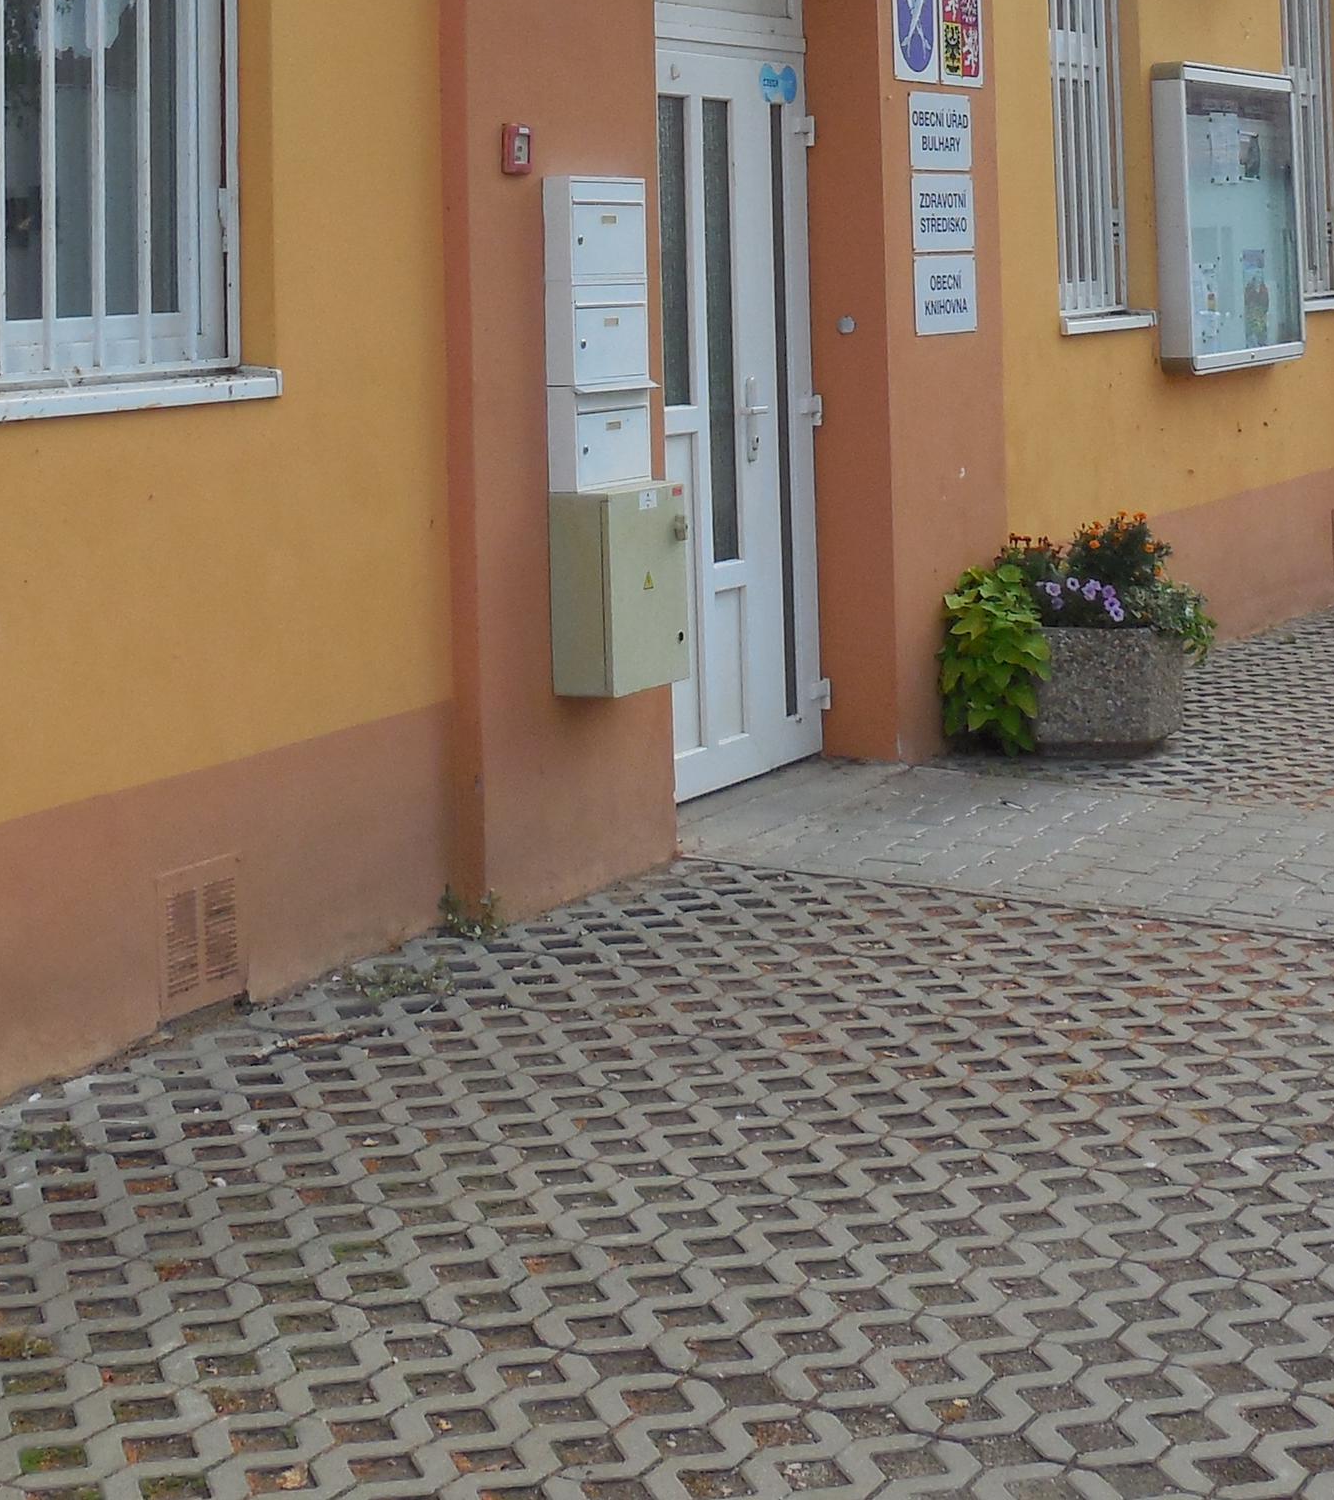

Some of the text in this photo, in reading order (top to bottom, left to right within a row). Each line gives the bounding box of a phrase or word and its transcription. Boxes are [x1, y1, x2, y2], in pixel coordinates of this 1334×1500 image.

[912, 108, 969, 129] OBECNÍ ÚŘAD
[921, 135, 961, 152] BULHARY
[919, 189, 967, 208] ZDRAVOTNÍ
[919, 213, 968, 233] STŘEDISKO
[929, 269, 962, 291] OBECNÍ
[924, 298, 969, 316] KNIHOVNA
